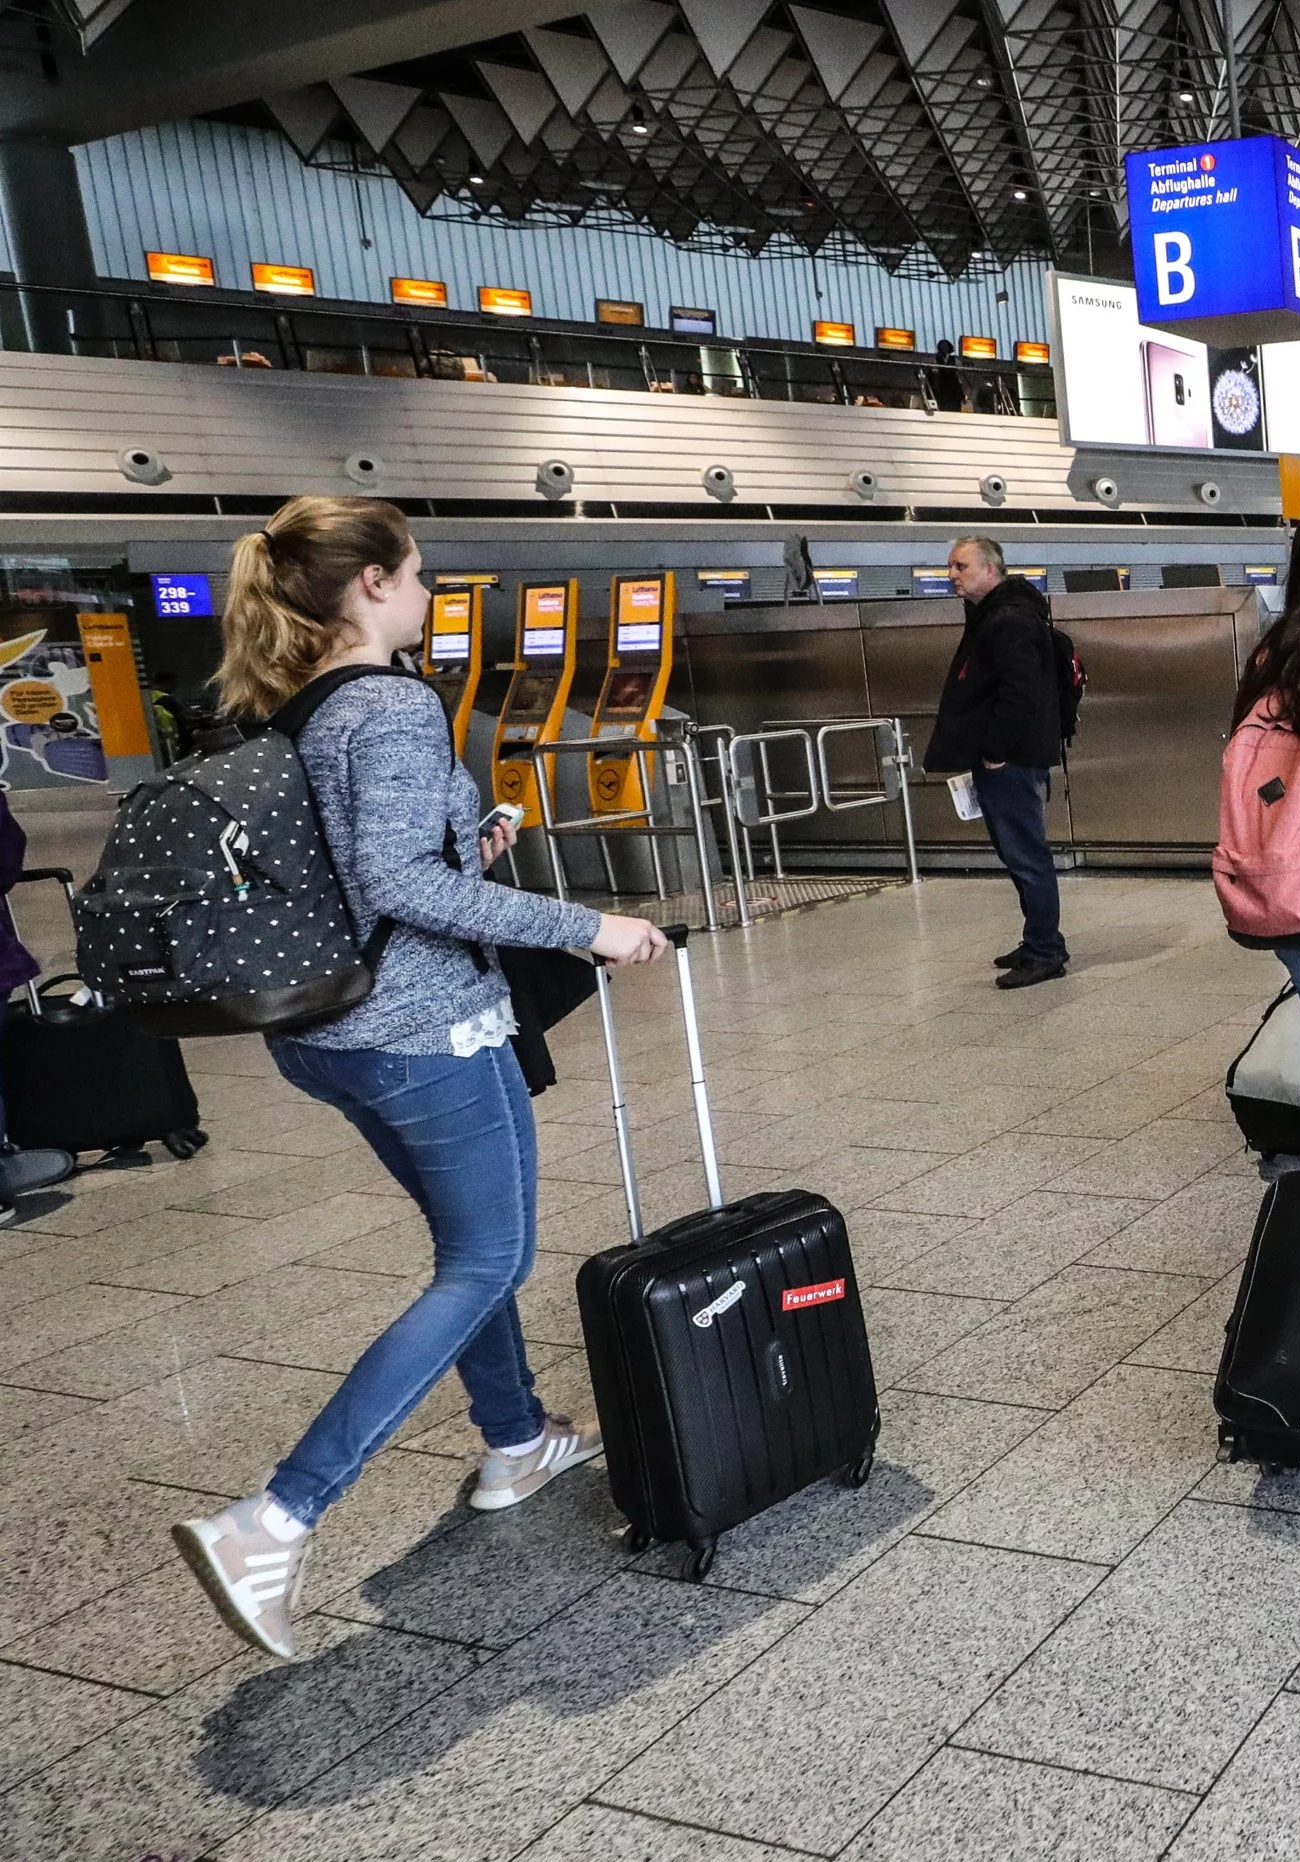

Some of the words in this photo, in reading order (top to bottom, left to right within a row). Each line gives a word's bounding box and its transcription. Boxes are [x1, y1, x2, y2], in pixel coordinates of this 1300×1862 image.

[1148, 158, 1197, 177] Terminal
[1150, 174, 1216, 195] Abflughalle
[1151, 193, 1213, 213] Departures
[1215, 188, 1238, 204] hall
[1153, 231, 1196, 306] B
[1071, 295, 1122, 310] SAMSUNG
[161, 602, 190, 614] 339
[128, 967, 166, 976] EASTPAK
[709, 1282, 744, 1313] HARVARD
[786, 1284, 842, 1305] Feuerwerk
